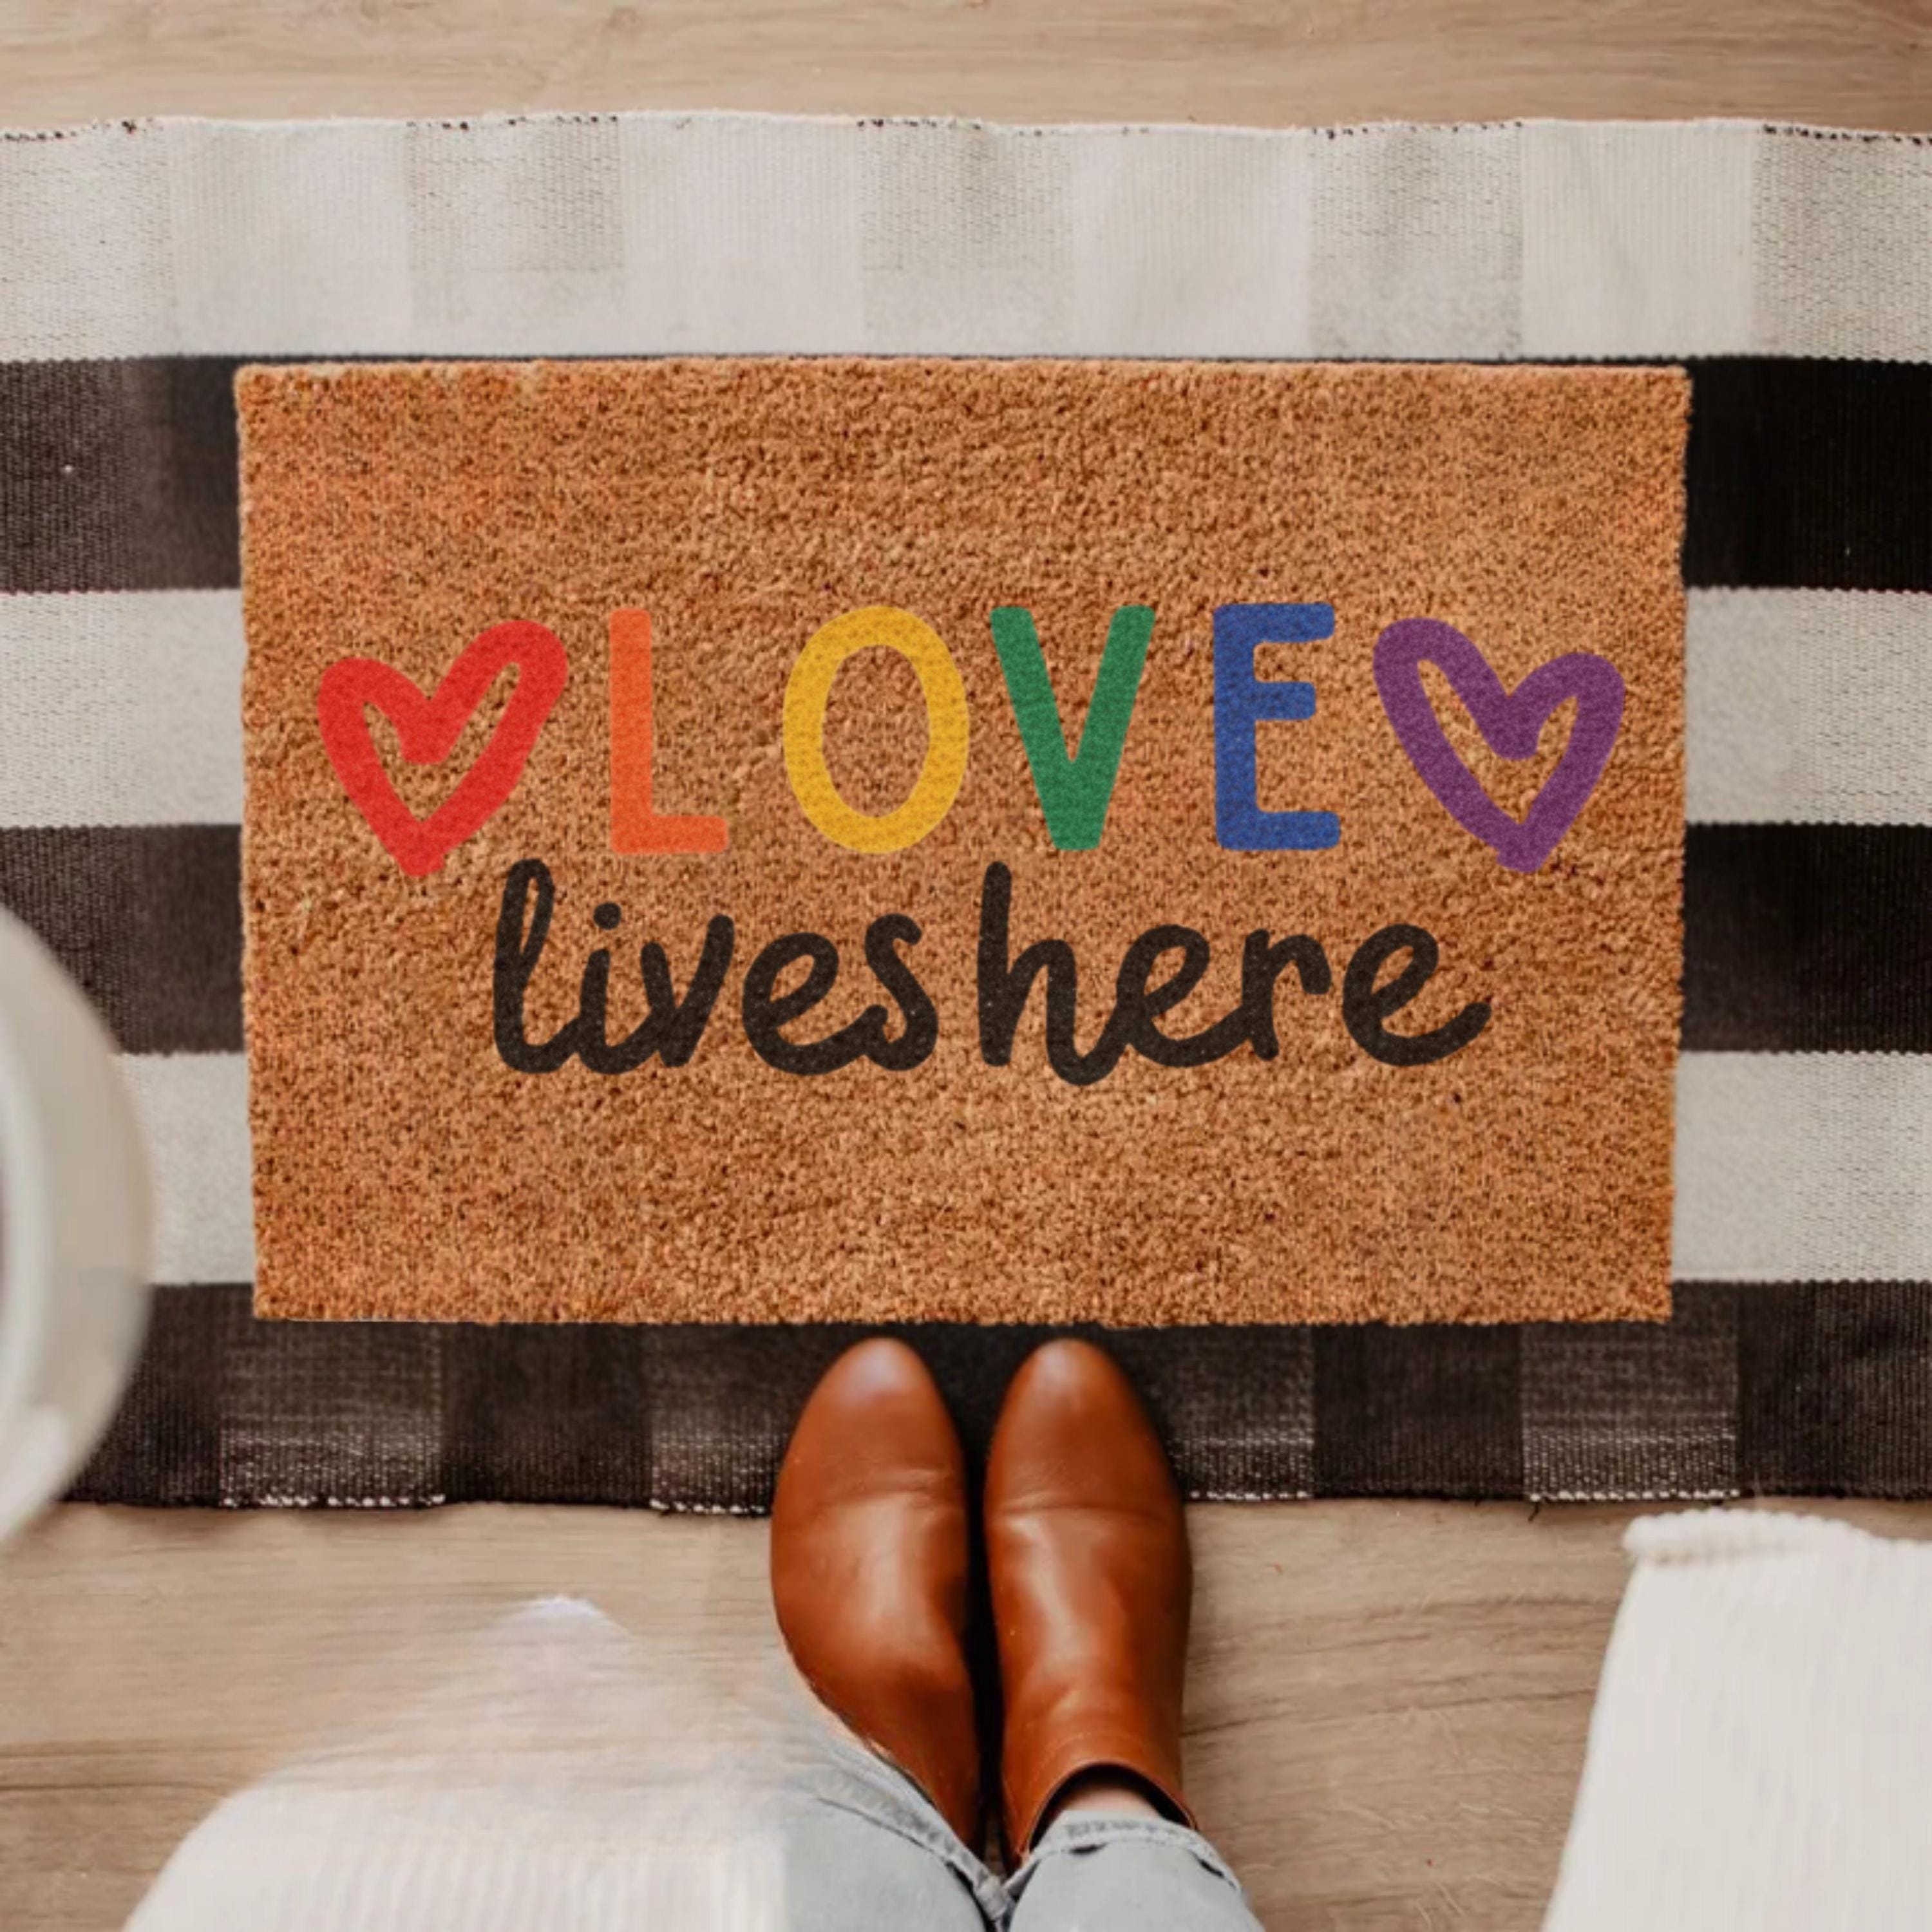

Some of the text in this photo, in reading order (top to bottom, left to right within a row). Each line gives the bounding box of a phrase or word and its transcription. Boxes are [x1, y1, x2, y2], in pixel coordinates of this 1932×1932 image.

[609, 603, 1341, 855] LOVE
[493, 858, 1492, 1086] lives here
